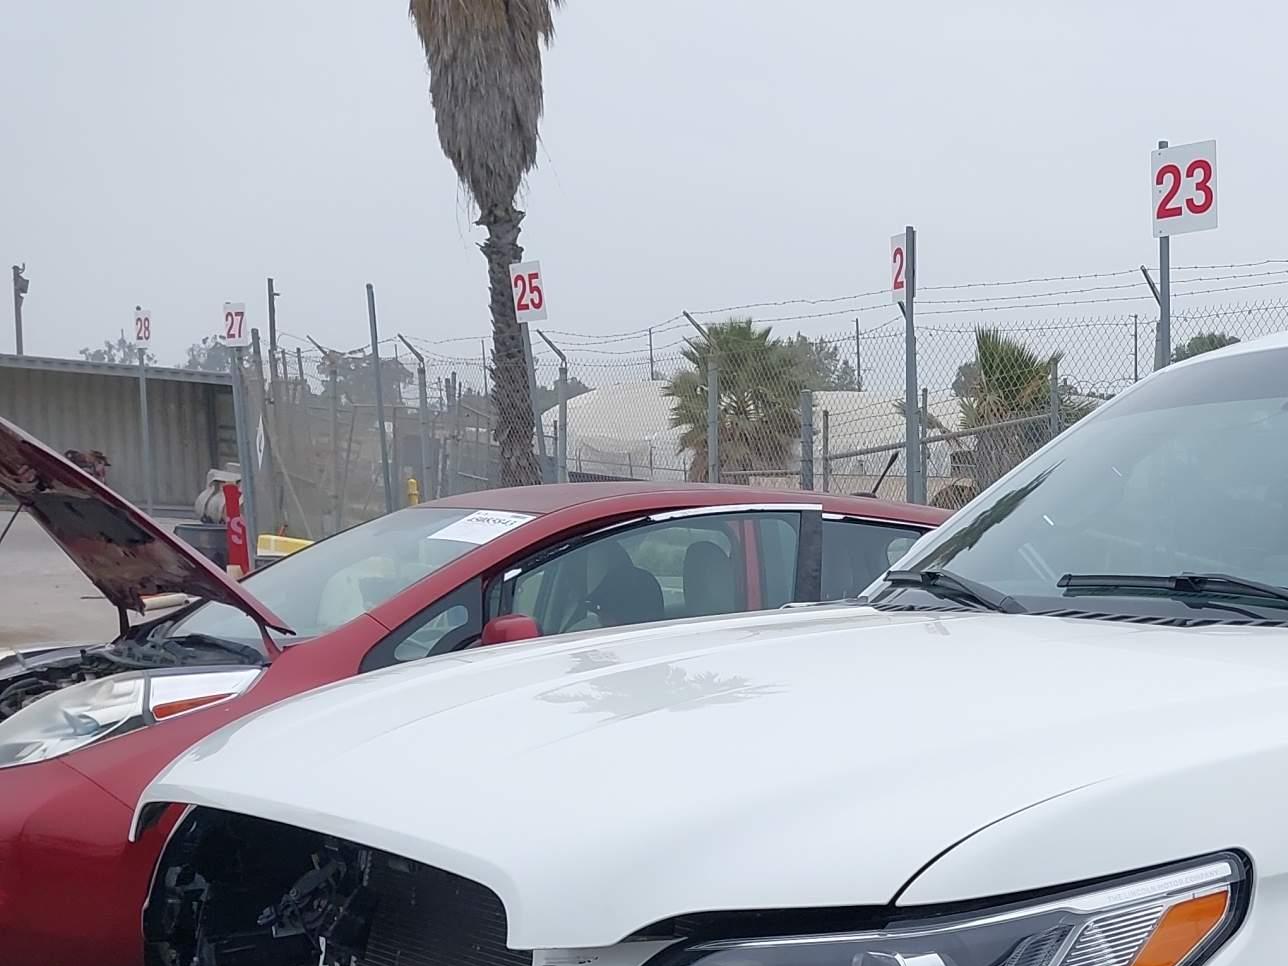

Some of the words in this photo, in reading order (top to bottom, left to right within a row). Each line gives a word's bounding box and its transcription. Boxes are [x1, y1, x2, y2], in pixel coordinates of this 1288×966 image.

[1156, 160, 1213, 219] 23
[893, 247, 904, 290] 2
[514, 273, 543, 311] 25
[136, 317, 150, 341] 28
[225, 311, 244, 339] 27
